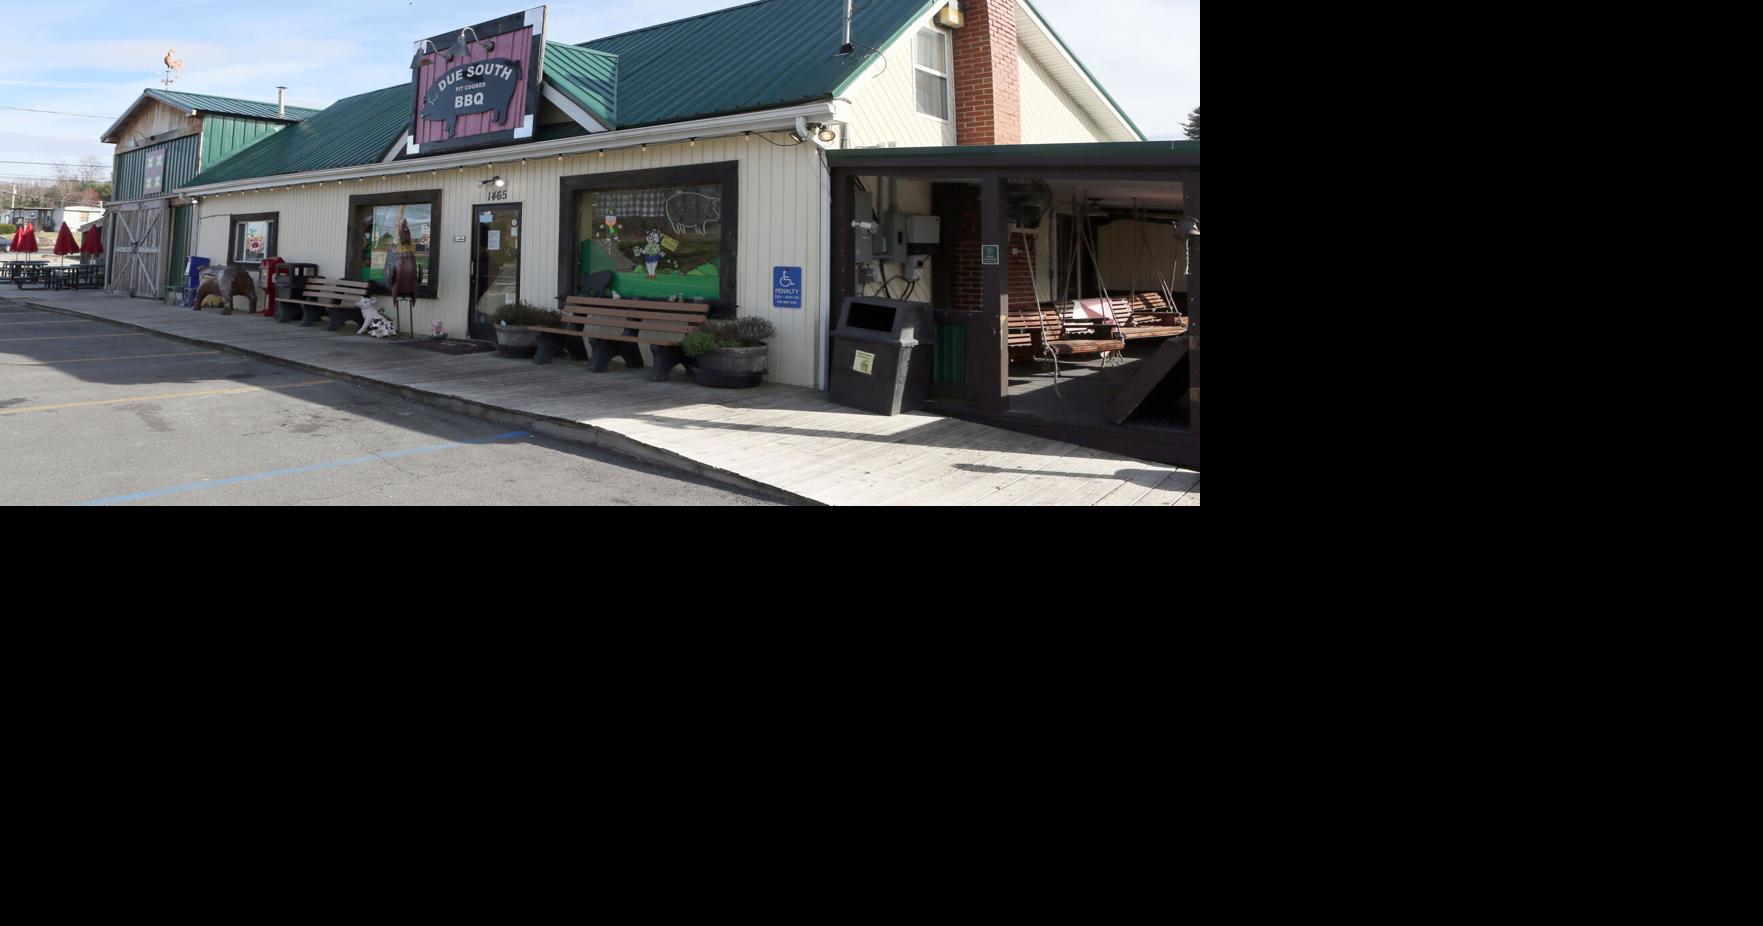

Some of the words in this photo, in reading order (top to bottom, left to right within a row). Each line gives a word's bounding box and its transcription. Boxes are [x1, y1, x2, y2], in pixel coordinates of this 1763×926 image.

[438, 69, 463, 91] DUE
[466, 63, 512, 80] SOUTH
[465, 82, 486, 90] COOKED
[454, 92, 484, 108] BBQ
[488, 189, 508, 201] 1465
